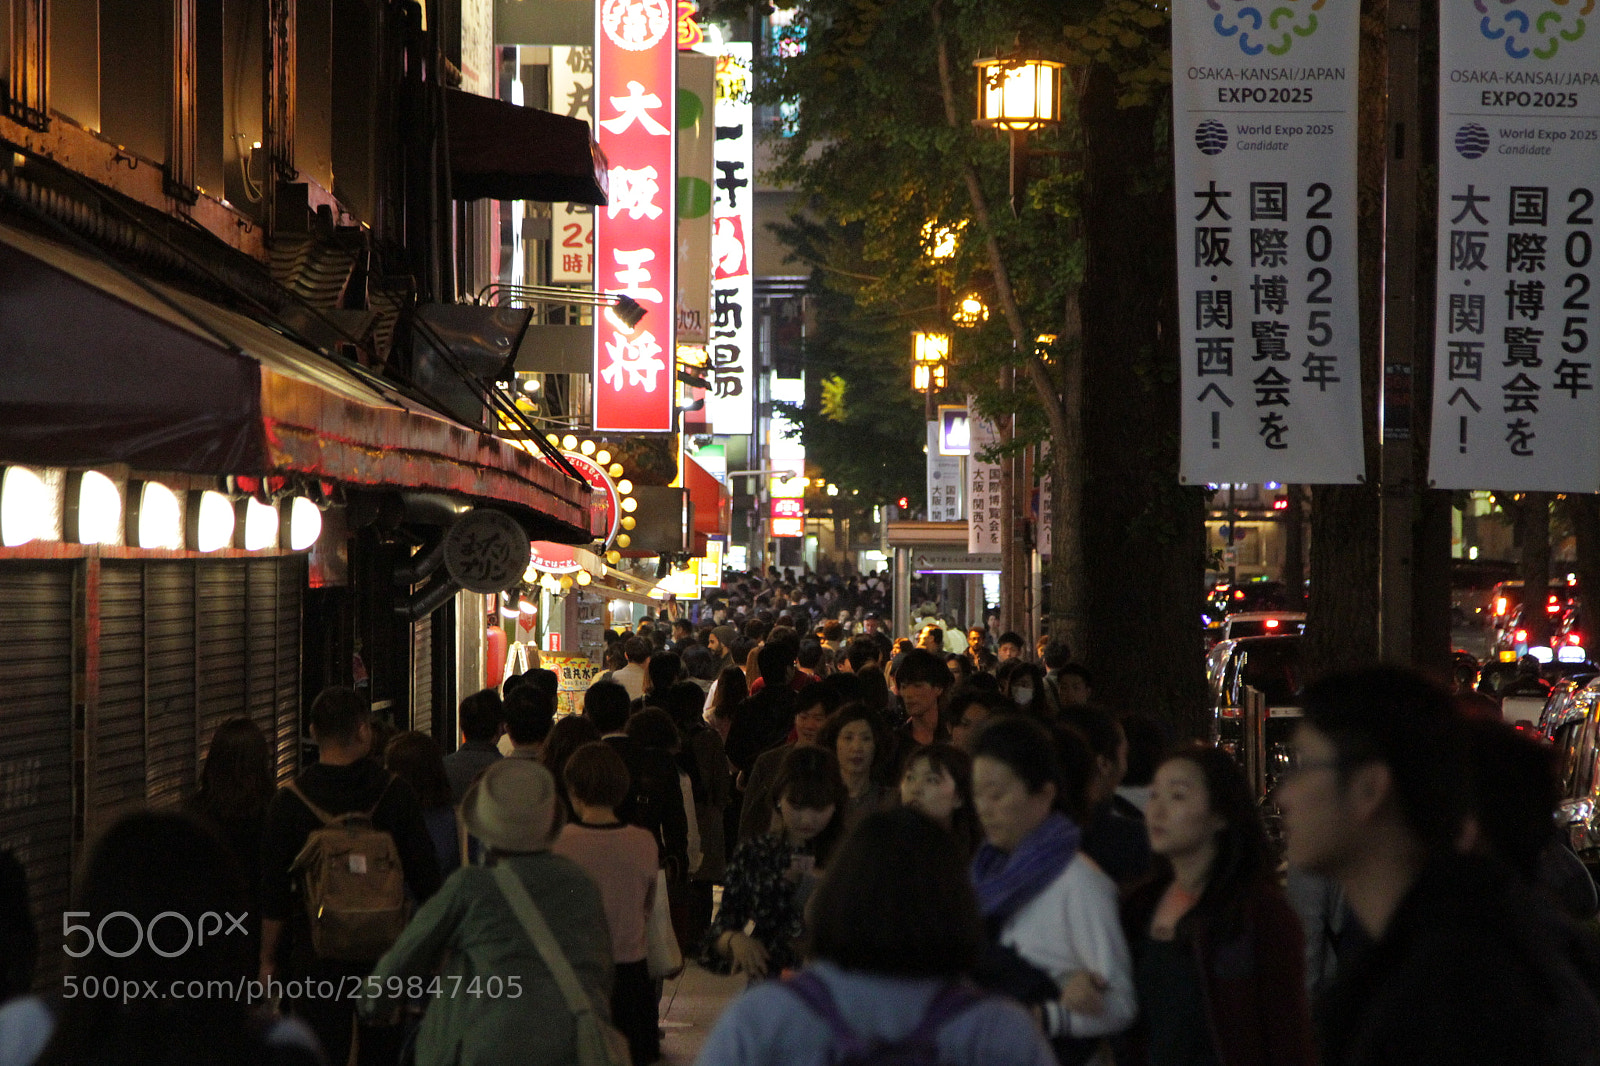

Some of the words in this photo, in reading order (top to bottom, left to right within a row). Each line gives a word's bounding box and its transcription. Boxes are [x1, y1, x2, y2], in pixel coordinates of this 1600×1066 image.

[1187, 66, 1345, 81] OSAKA-KANSAI/JAPAN
[1237, 125, 1271, 135] World
[1275, 125, 1303, 137] Expo
[1306, 125, 1334, 135] 2025
[1237, 140, 1289, 151] Candidate
[1498, 144, 1552, 156] Candidate
[1499, 128, 1534, 140] World
[1538, 129, 1567, 142] Expo
[1570, 129, 1598, 141] 2025
[599, 80, 670, 393] 大阪王将
[1302, 182, 1341, 392] 2025年
[1249, 181, 1292, 451] 国際博覧会を
[1501, 186, 1549, 457] 国際博覧会を
[1553, 187, 1596, 400] 2025年
